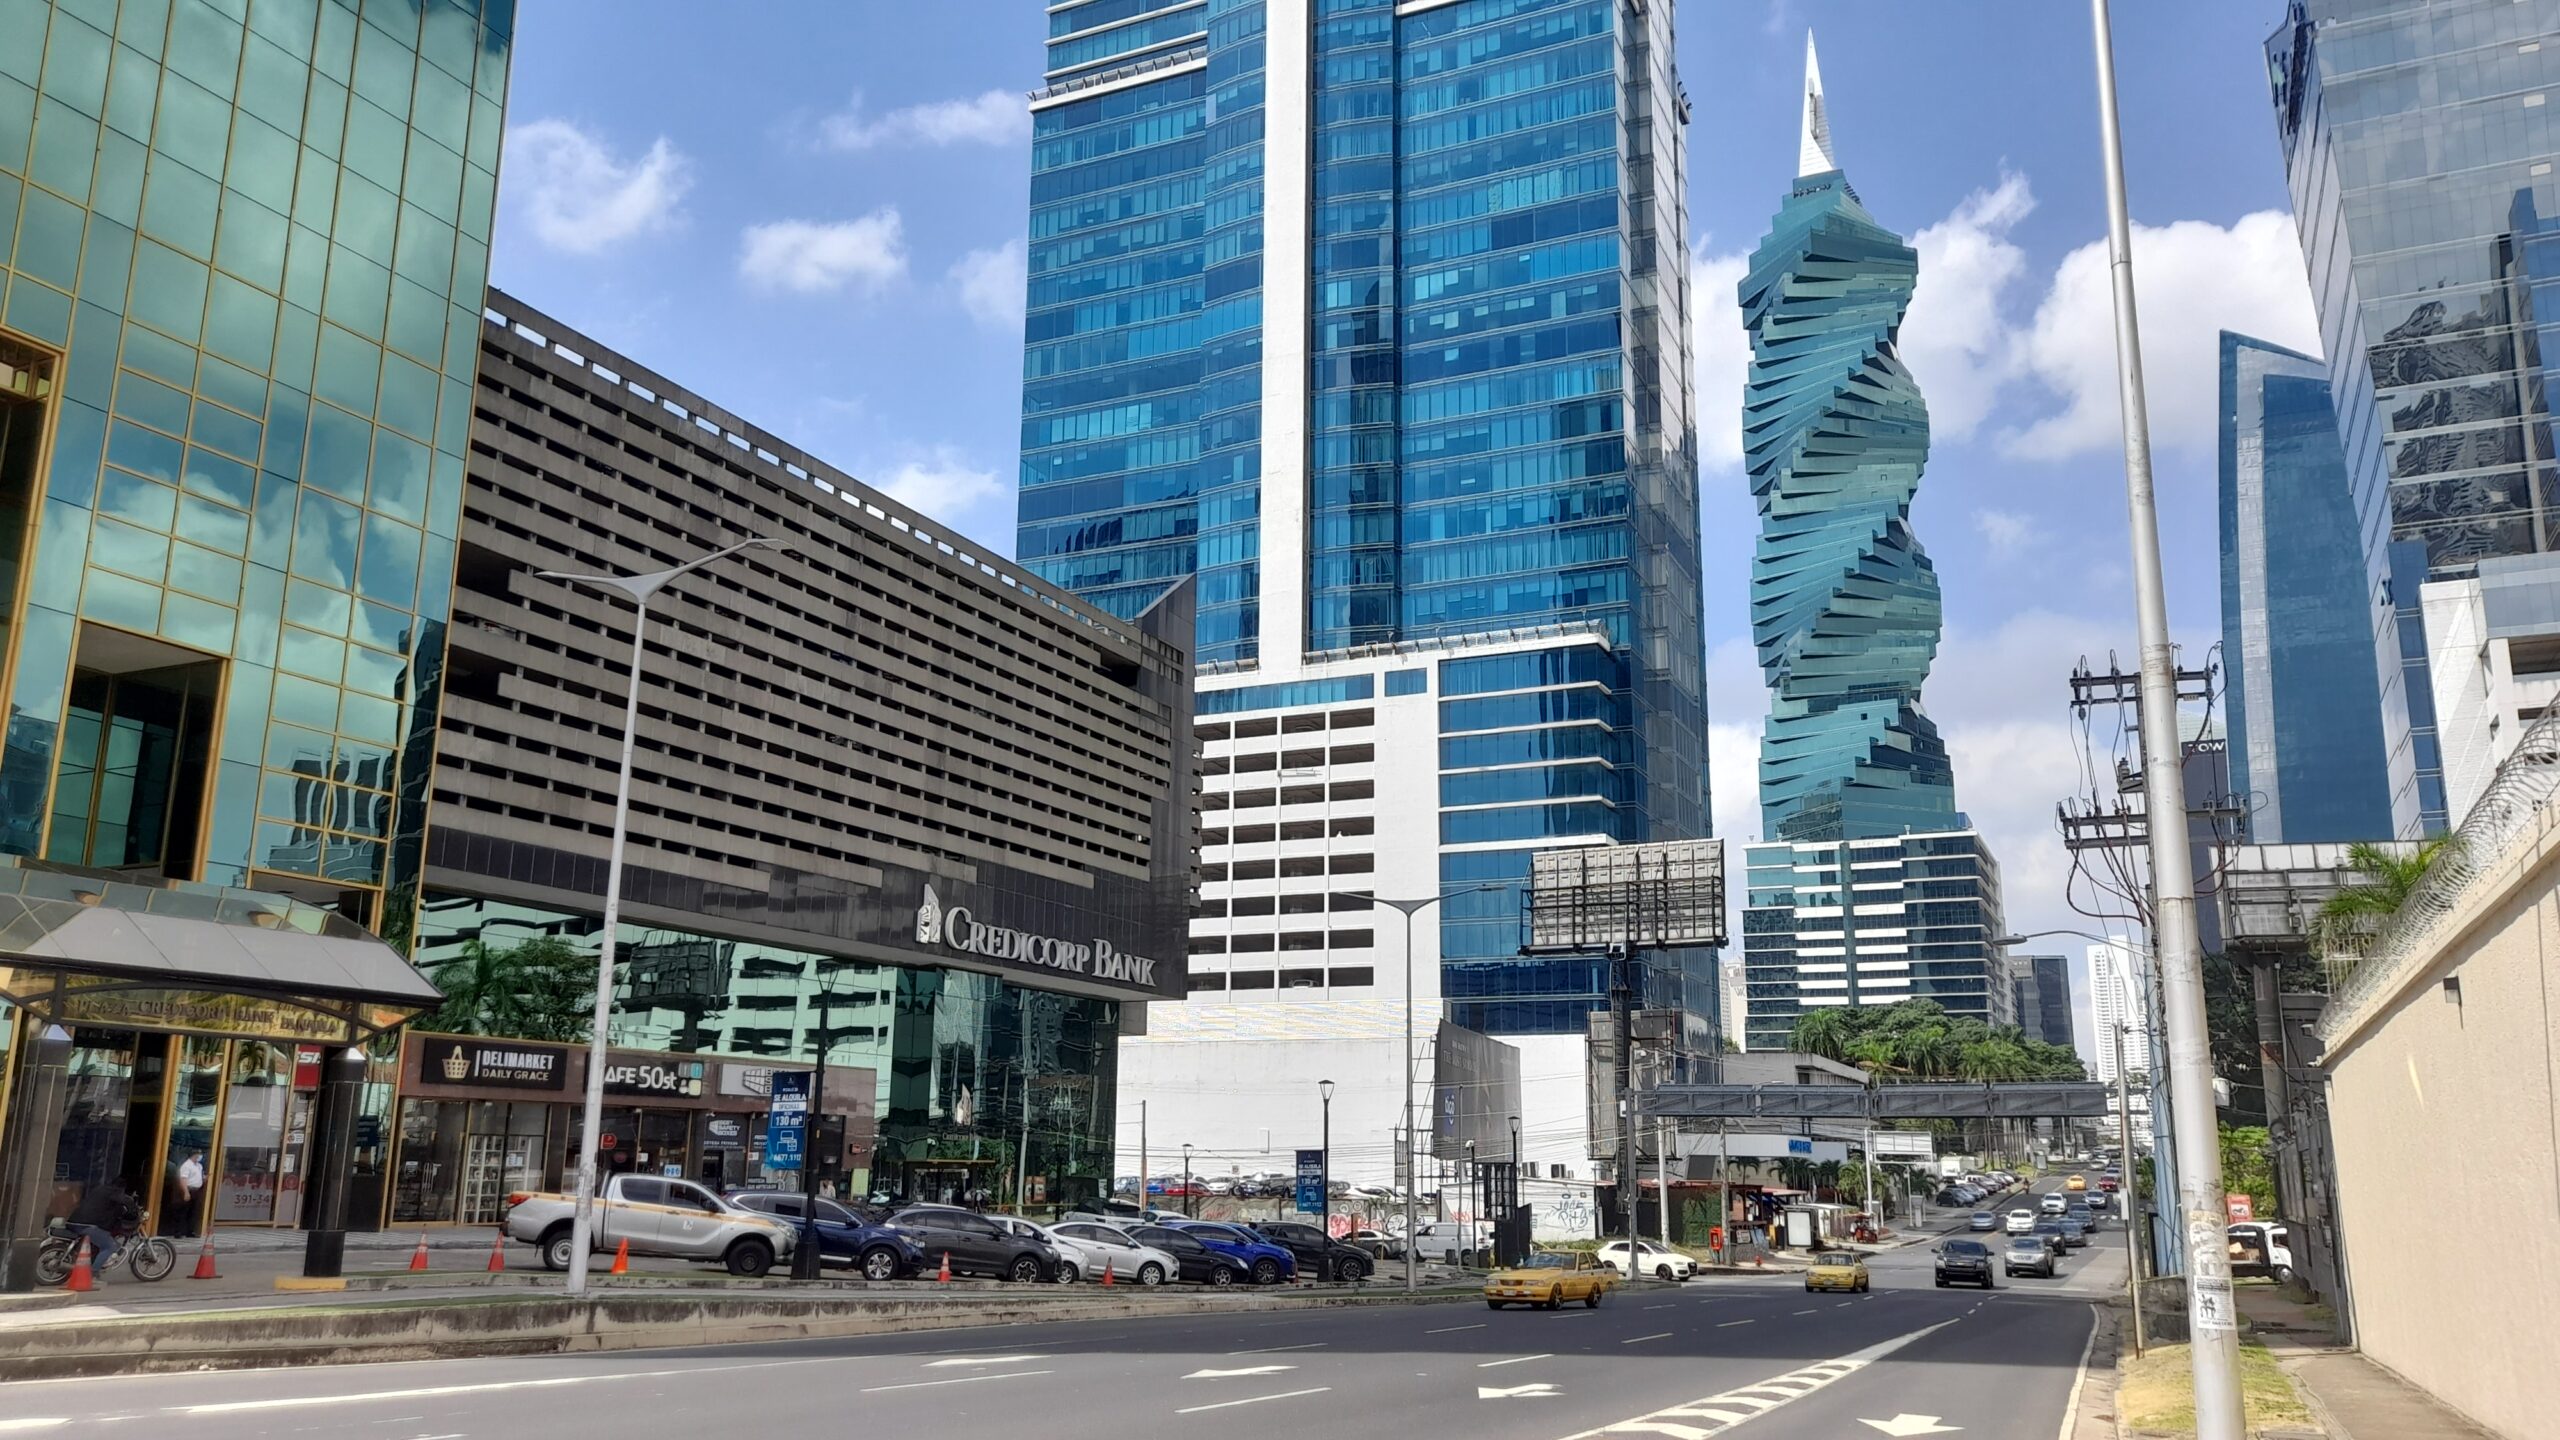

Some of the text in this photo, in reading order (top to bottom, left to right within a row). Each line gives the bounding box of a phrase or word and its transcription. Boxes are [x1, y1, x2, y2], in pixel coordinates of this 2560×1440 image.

[945, 906, 1156, 986] CREDICORP BANK
[482, 1050, 554, 1070] DELIMARKET
[482, 1069, 549, 1082] DAILY GRACE
[604, 1065, 637, 1084] AFE
